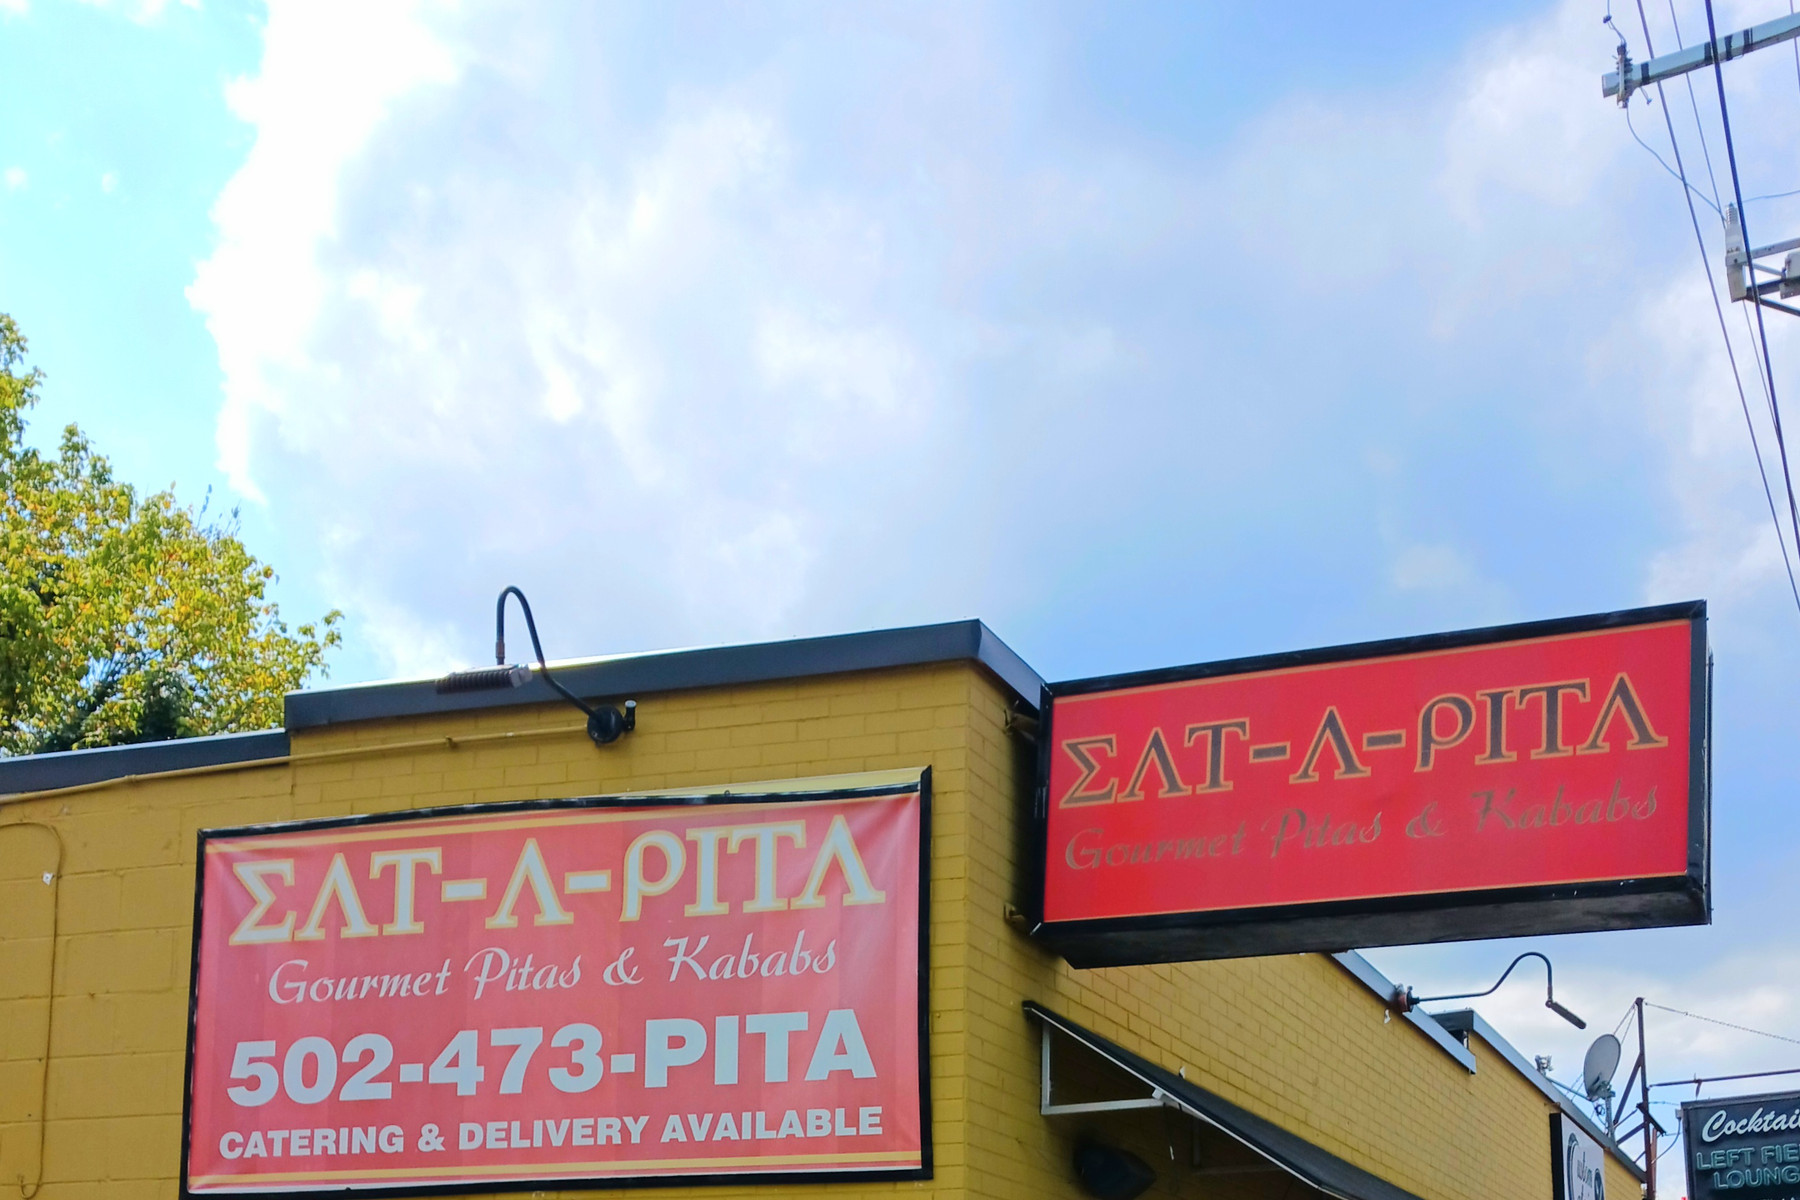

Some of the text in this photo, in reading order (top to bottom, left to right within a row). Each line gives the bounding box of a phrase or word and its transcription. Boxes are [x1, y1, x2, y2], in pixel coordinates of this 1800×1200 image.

[1065, 777, 1659, 871] Gourmet Pitas & Kababs
[268, 929, 838, 1004] Gourmet Pitas & Kababs
[226, 1007, 877, 1108] 502-473-PITA
[218, 1105, 885, 1160] CATERING & DELIVERY AVAILABLE
[1696, 1143, 1800, 1170] LEFT FIE
